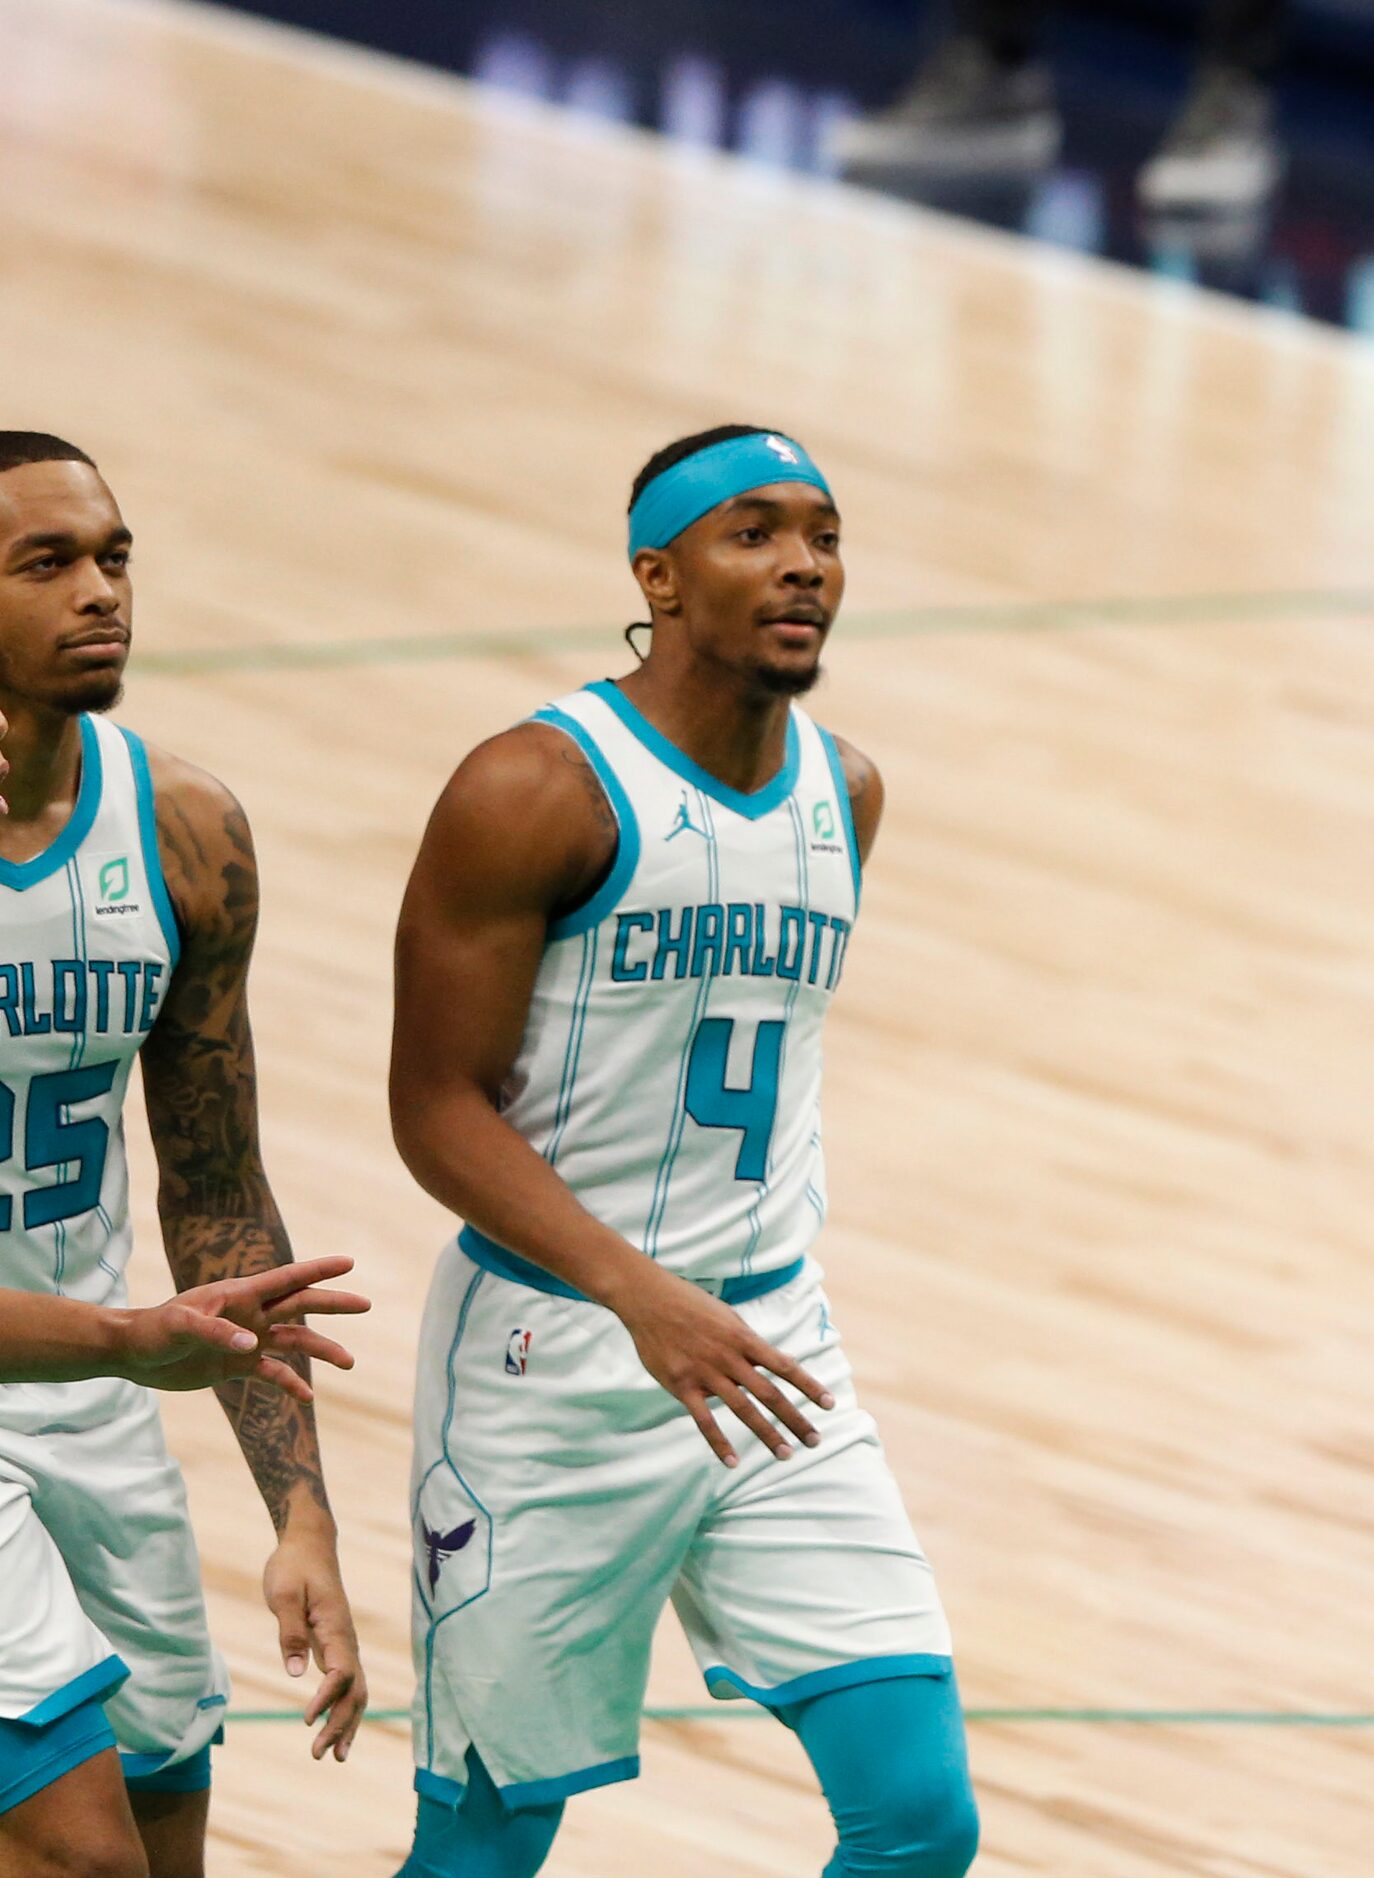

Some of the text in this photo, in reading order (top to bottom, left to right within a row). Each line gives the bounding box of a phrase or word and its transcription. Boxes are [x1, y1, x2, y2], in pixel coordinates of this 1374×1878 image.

[611, 903, 851, 991] CHARLOTT
[0, 1058, 122, 1231] 5
[684, 1017, 787, 1182] 4
